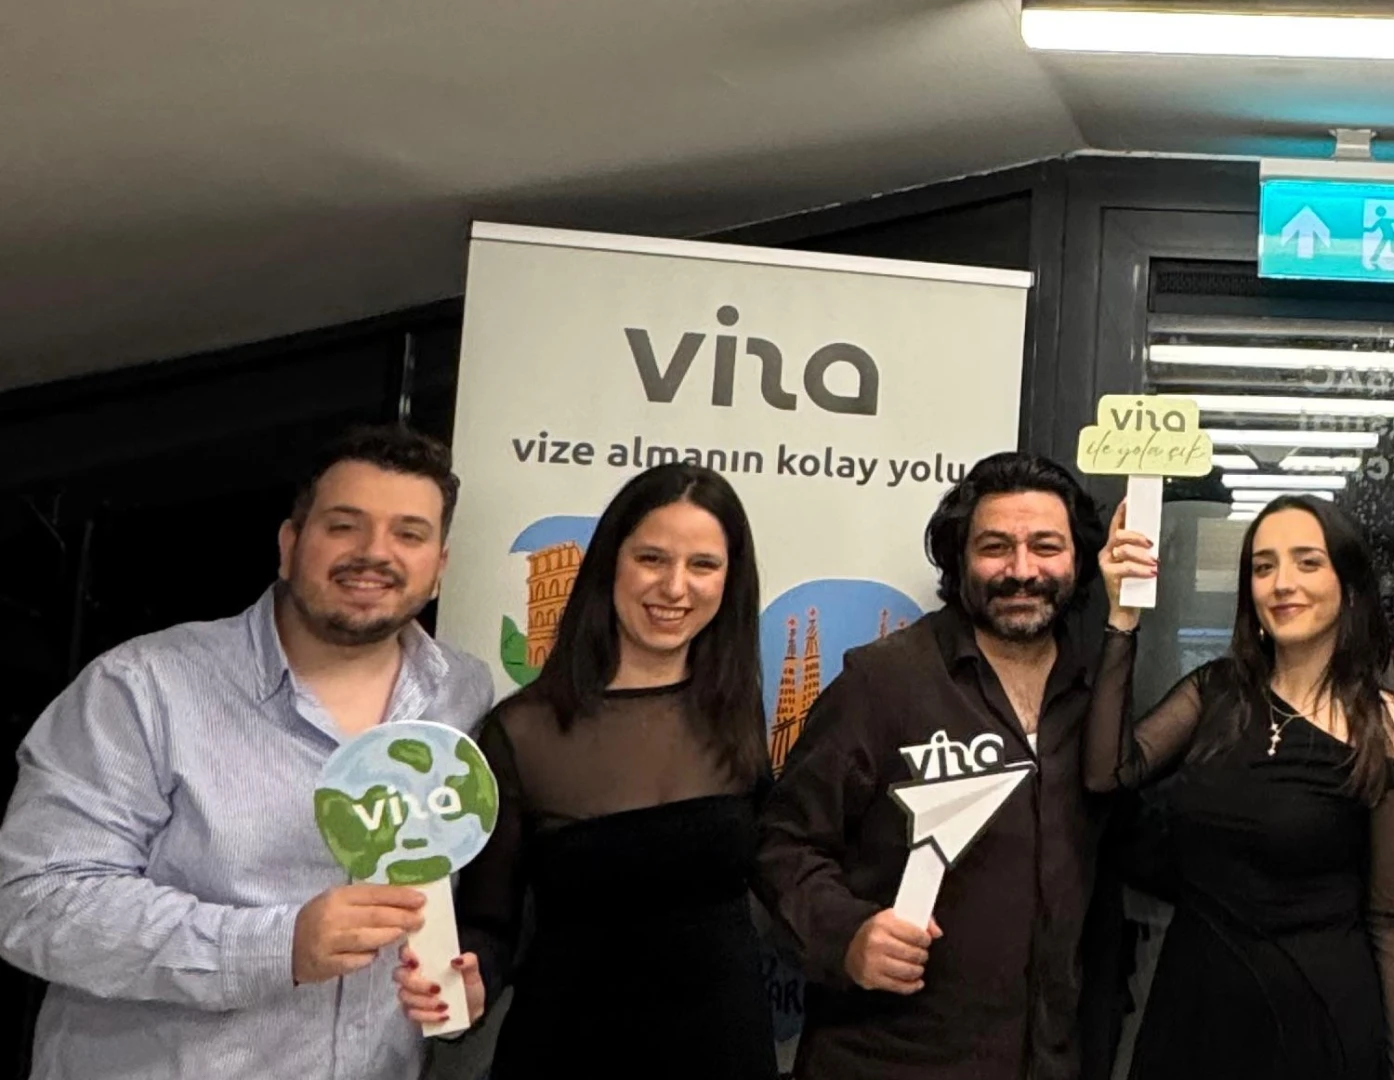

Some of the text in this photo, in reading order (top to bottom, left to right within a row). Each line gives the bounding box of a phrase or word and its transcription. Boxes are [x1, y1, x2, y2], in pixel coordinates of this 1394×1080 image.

[512, 431, 965, 485] vize almanın kolay yolu
